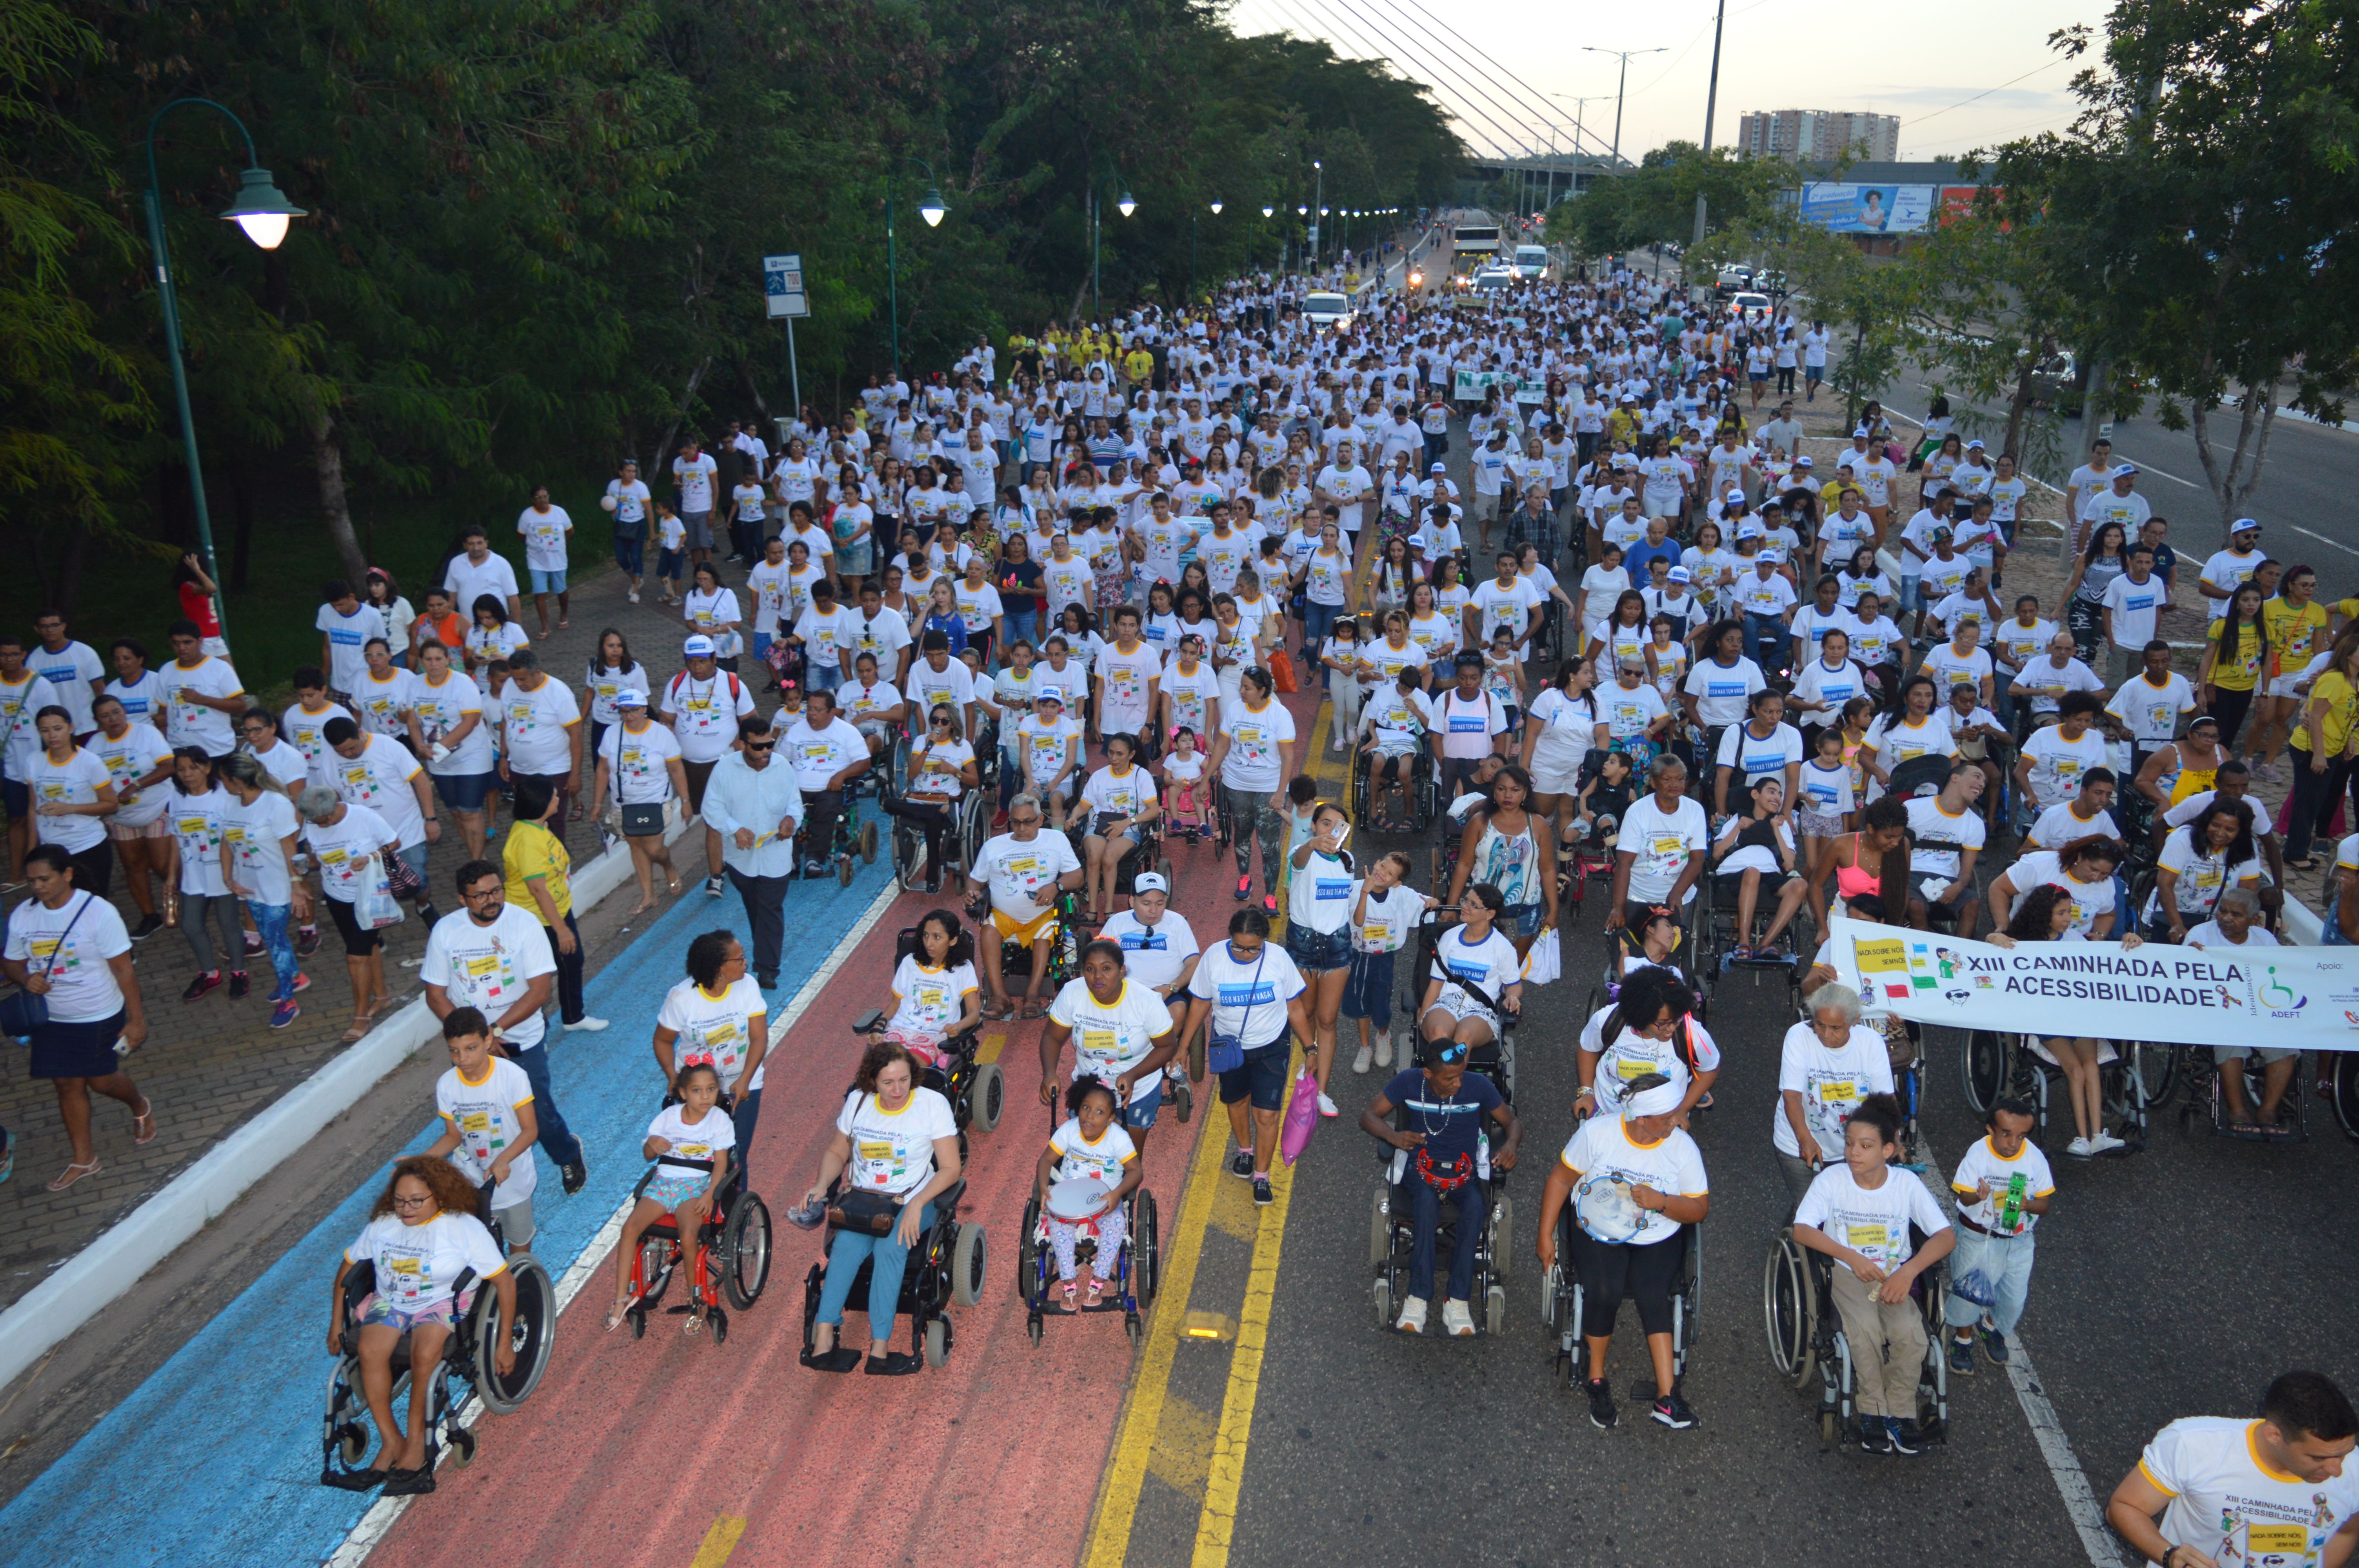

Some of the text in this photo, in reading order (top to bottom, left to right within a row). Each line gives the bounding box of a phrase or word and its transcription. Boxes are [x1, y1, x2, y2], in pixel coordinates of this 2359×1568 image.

[1819, 191, 1855, 200] graduação
[1966, 956, 2244, 982] XIII CAMINHADA PELA
[2316, 962, 2344, 971] Apoio:
[2005, 976, 2216, 1007] ACESSIBILIDADE
[2245, 964, 2257, 1016] Idealização:
[1233, 994, 1244, 1003] NÃO
[1256, 990, 1273, 1000] VAGA!
[1079, 1020, 1116, 1030] ACESSIBILIDADE
[1083, 1015, 1109, 1024] CAMINHADA
[856, 1131, 894, 1142] ACESSIBILIDADE
[860, 1127, 886, 1135] CAMINHADA
[1615, 1167, 1645, 1178] CAMINHADA
[1838, 1214, 1888, 1224] ACESSIBILIDADE
[1841, 1210, 1878, 1218] CAMINHADA
[2225, 1494, 2295, 1514] XIII CAMINHADA
[2235, 1506, 2310, 1524] ACESSIBILIDADE
